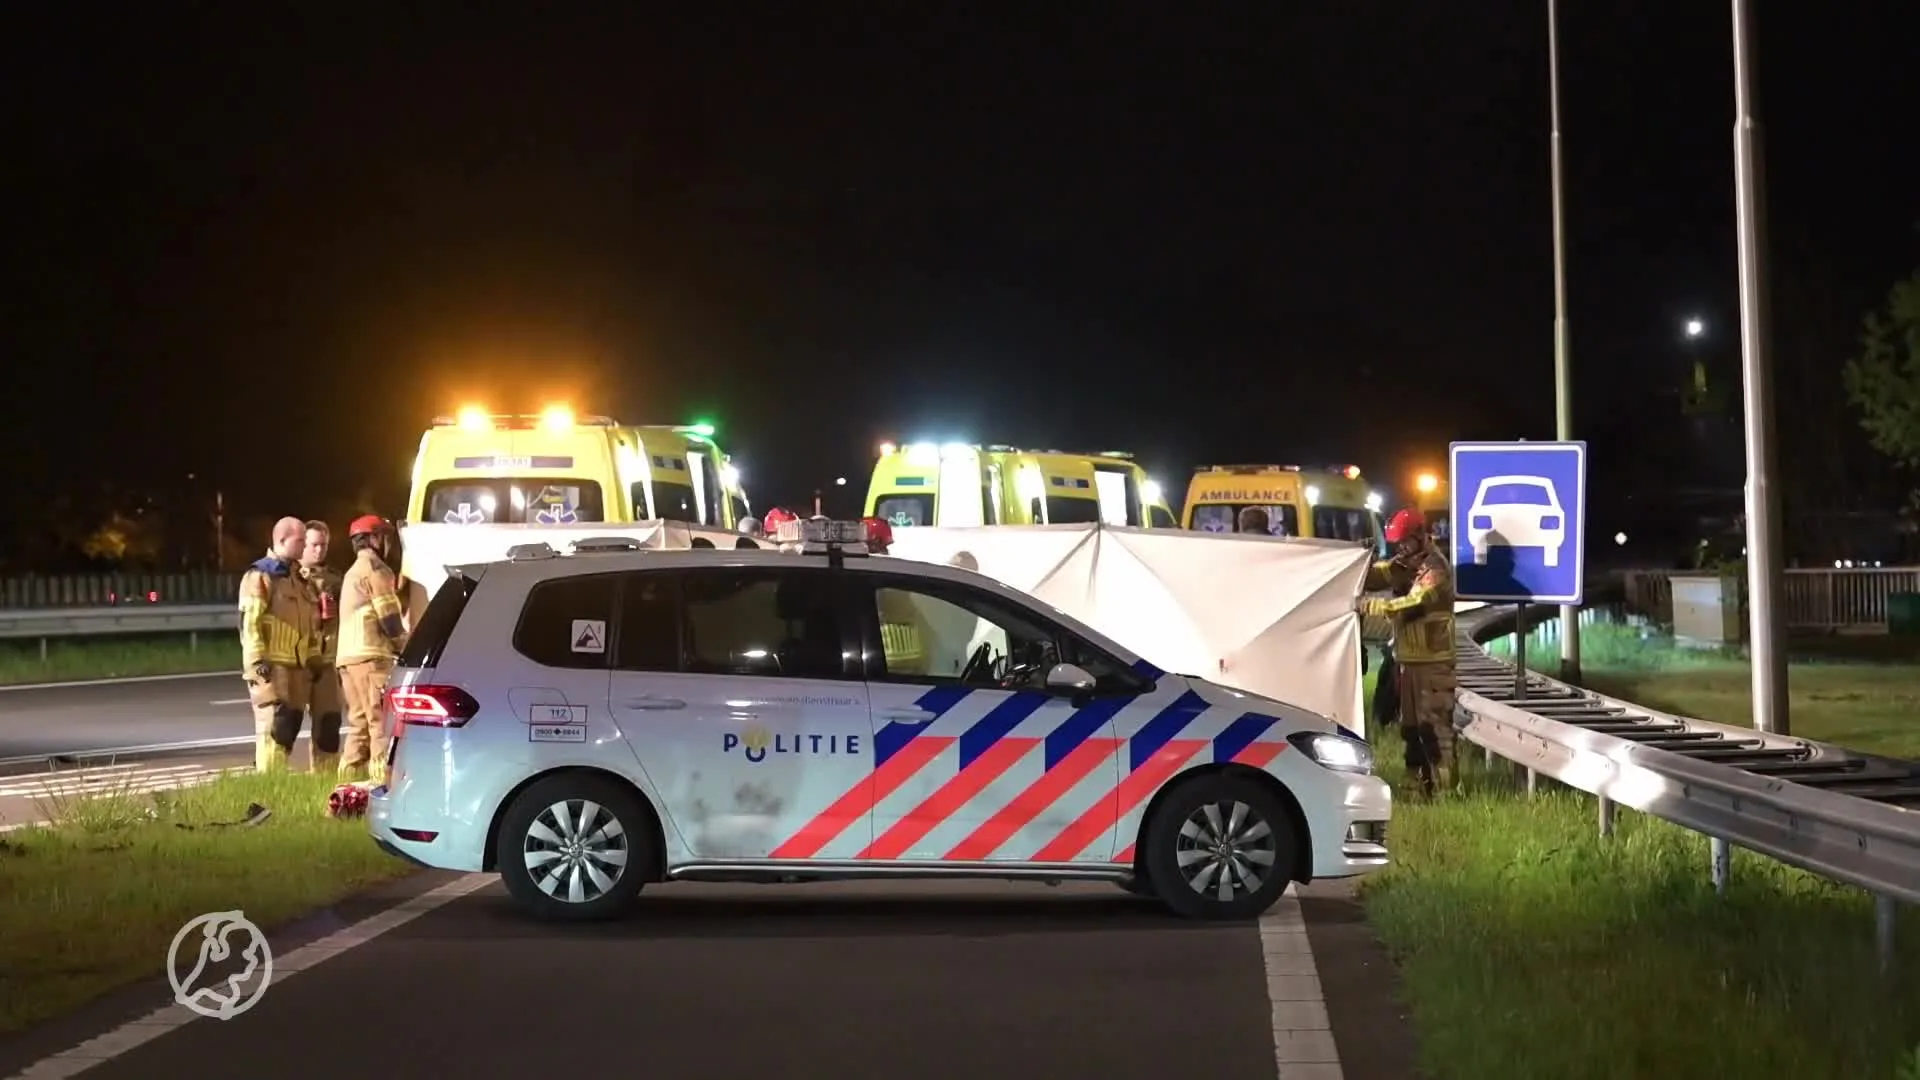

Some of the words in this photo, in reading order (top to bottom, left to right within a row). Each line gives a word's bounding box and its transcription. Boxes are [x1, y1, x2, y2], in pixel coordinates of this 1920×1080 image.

[1200, 489, 1290, 500] AMBULANCE
[550, 708, 566, 720] 112
[723, 732, 859, 762] POLITIE
